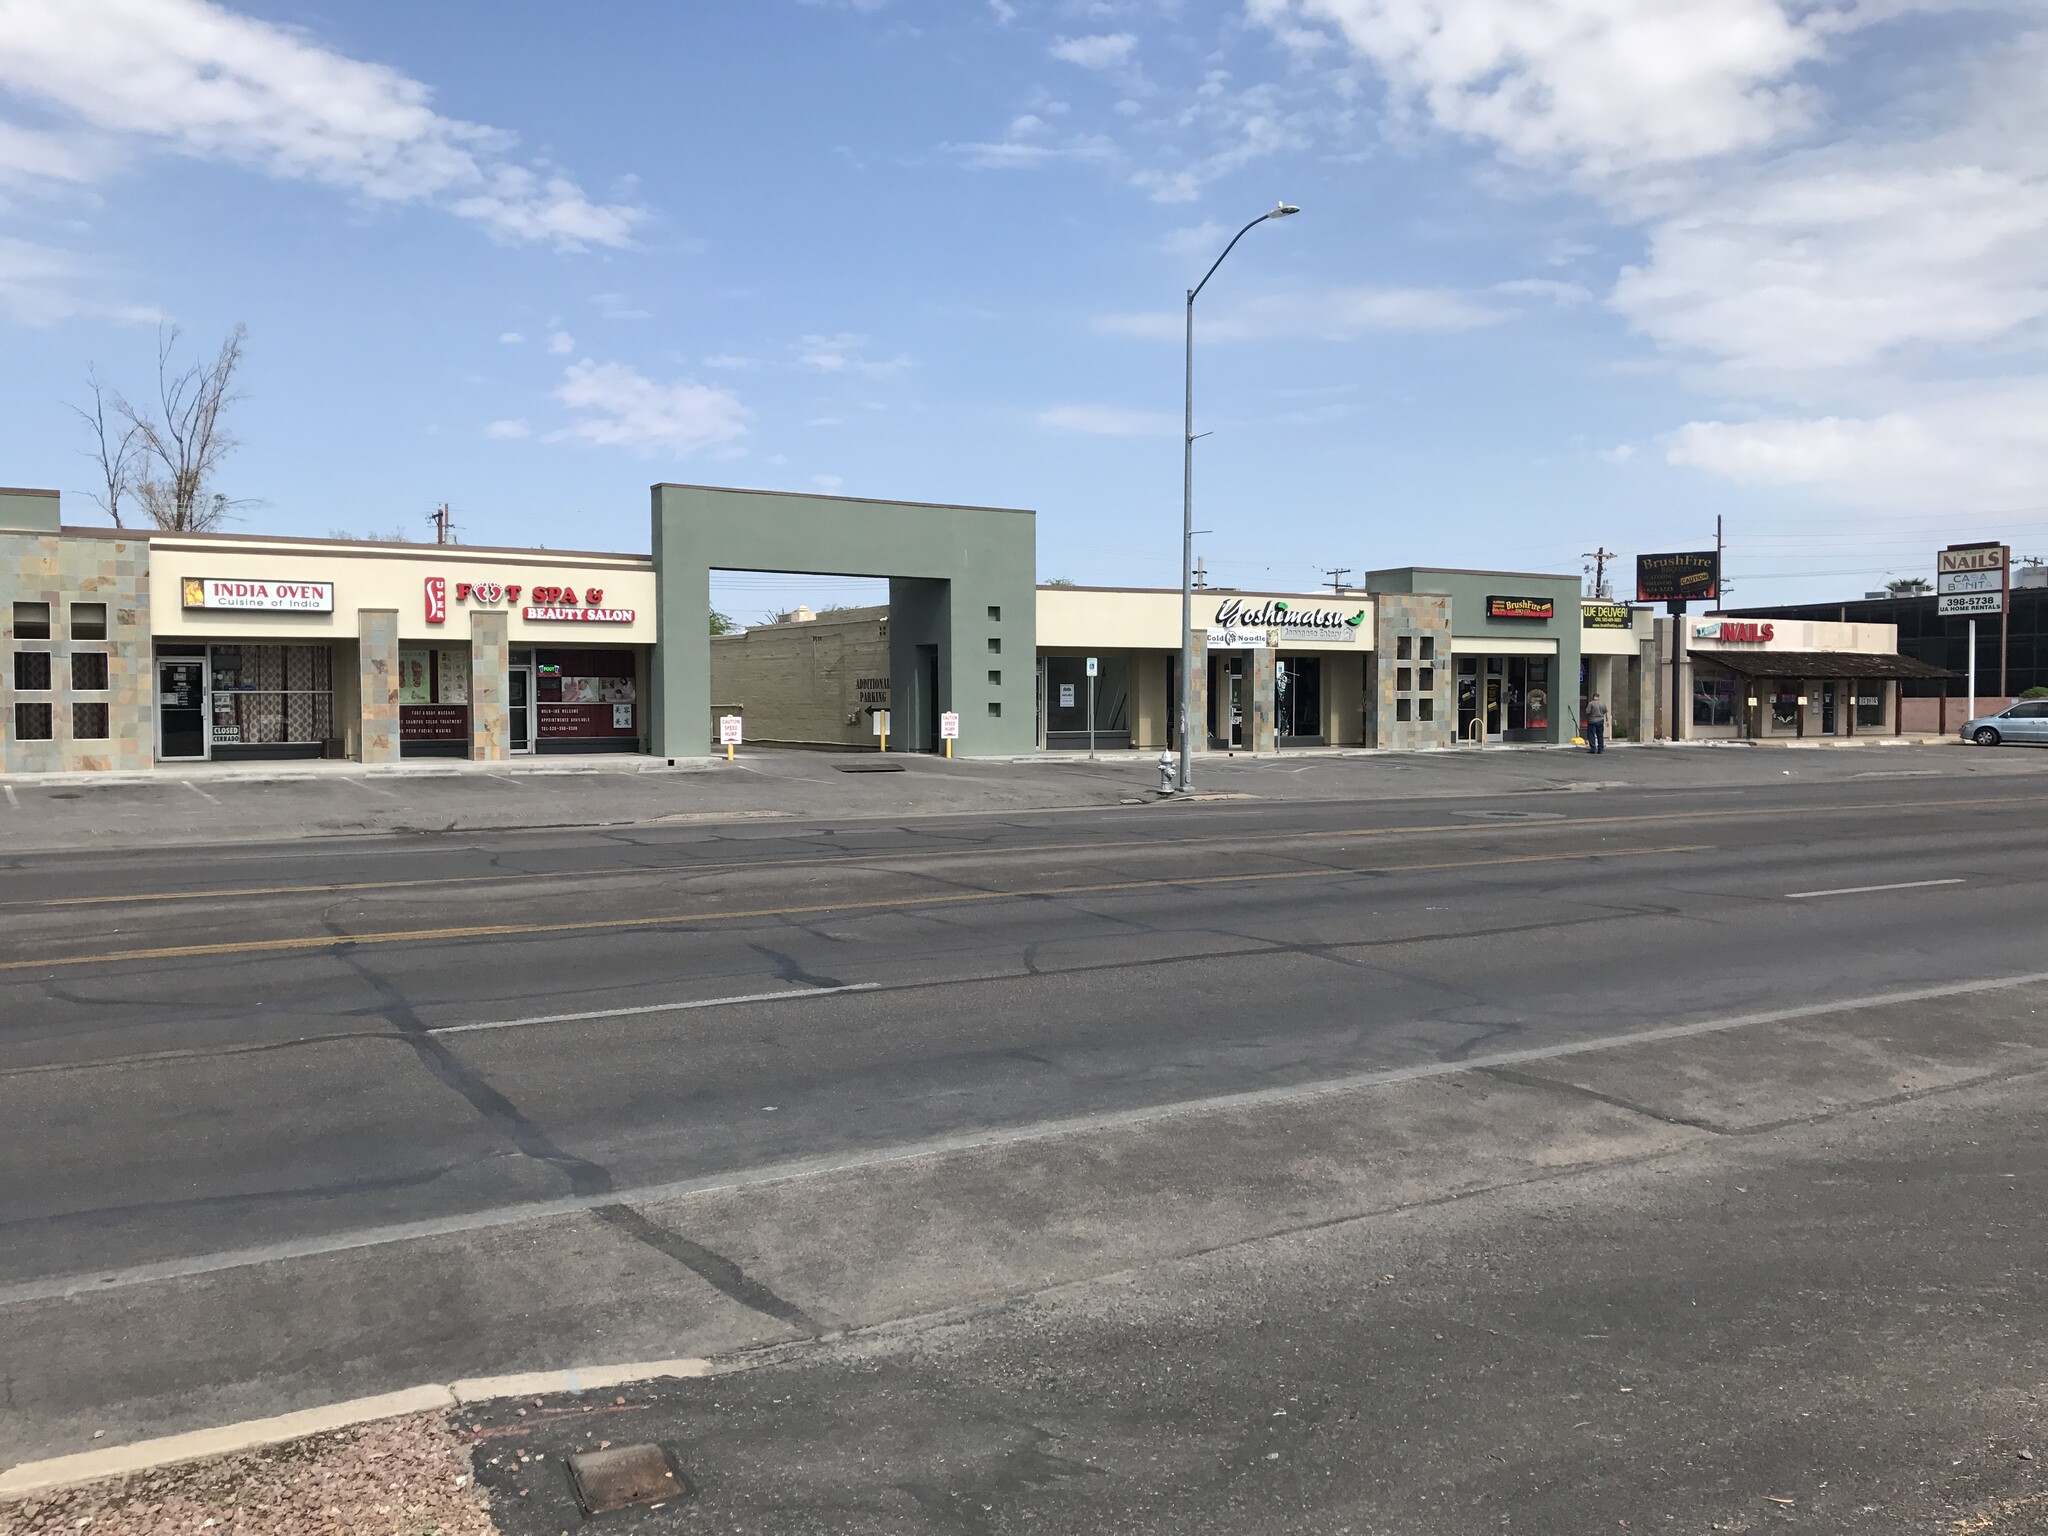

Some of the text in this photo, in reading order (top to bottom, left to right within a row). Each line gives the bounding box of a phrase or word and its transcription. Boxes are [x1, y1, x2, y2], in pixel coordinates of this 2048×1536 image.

[1643, 555, 1712, 570] BrushFire
[1943, 552, 2000, 570] NAILS
[1682, 573, 1708, 585] CAUTION
[1953, 573, 1987, 583] CASA
[1948, 580, 1993, 591] BONITA
[213, 583, 324, 600] INDIA OVEN
[532, 586, 579, 604] SPA
[586, 587, 604, 605] &
[218, 597, 320, 608] Cuisine of India
[1506, 600, 1541, 611] BrushFire
[1946, 597, 1994, 606] 398-5738
[527, 607, 633, 622] BEAUTY SALON
[1216, 599, 1345, 628] Yoshimatsu
[1583, 607, 1628, 618] WE DELIVER!
[1284, 628, 1342, 639] Japanese Eatery
[1722, 622, 1774, 642] NAILS
[856, 678, 890, 690] ADDITIONAL
[859, 691, 887, 702] PARKING
[1858, 696, 1879, 705] RENTALS
[213, 727, 238, 735] CLOSED
[213, 735, 239, 743] CERRADO
